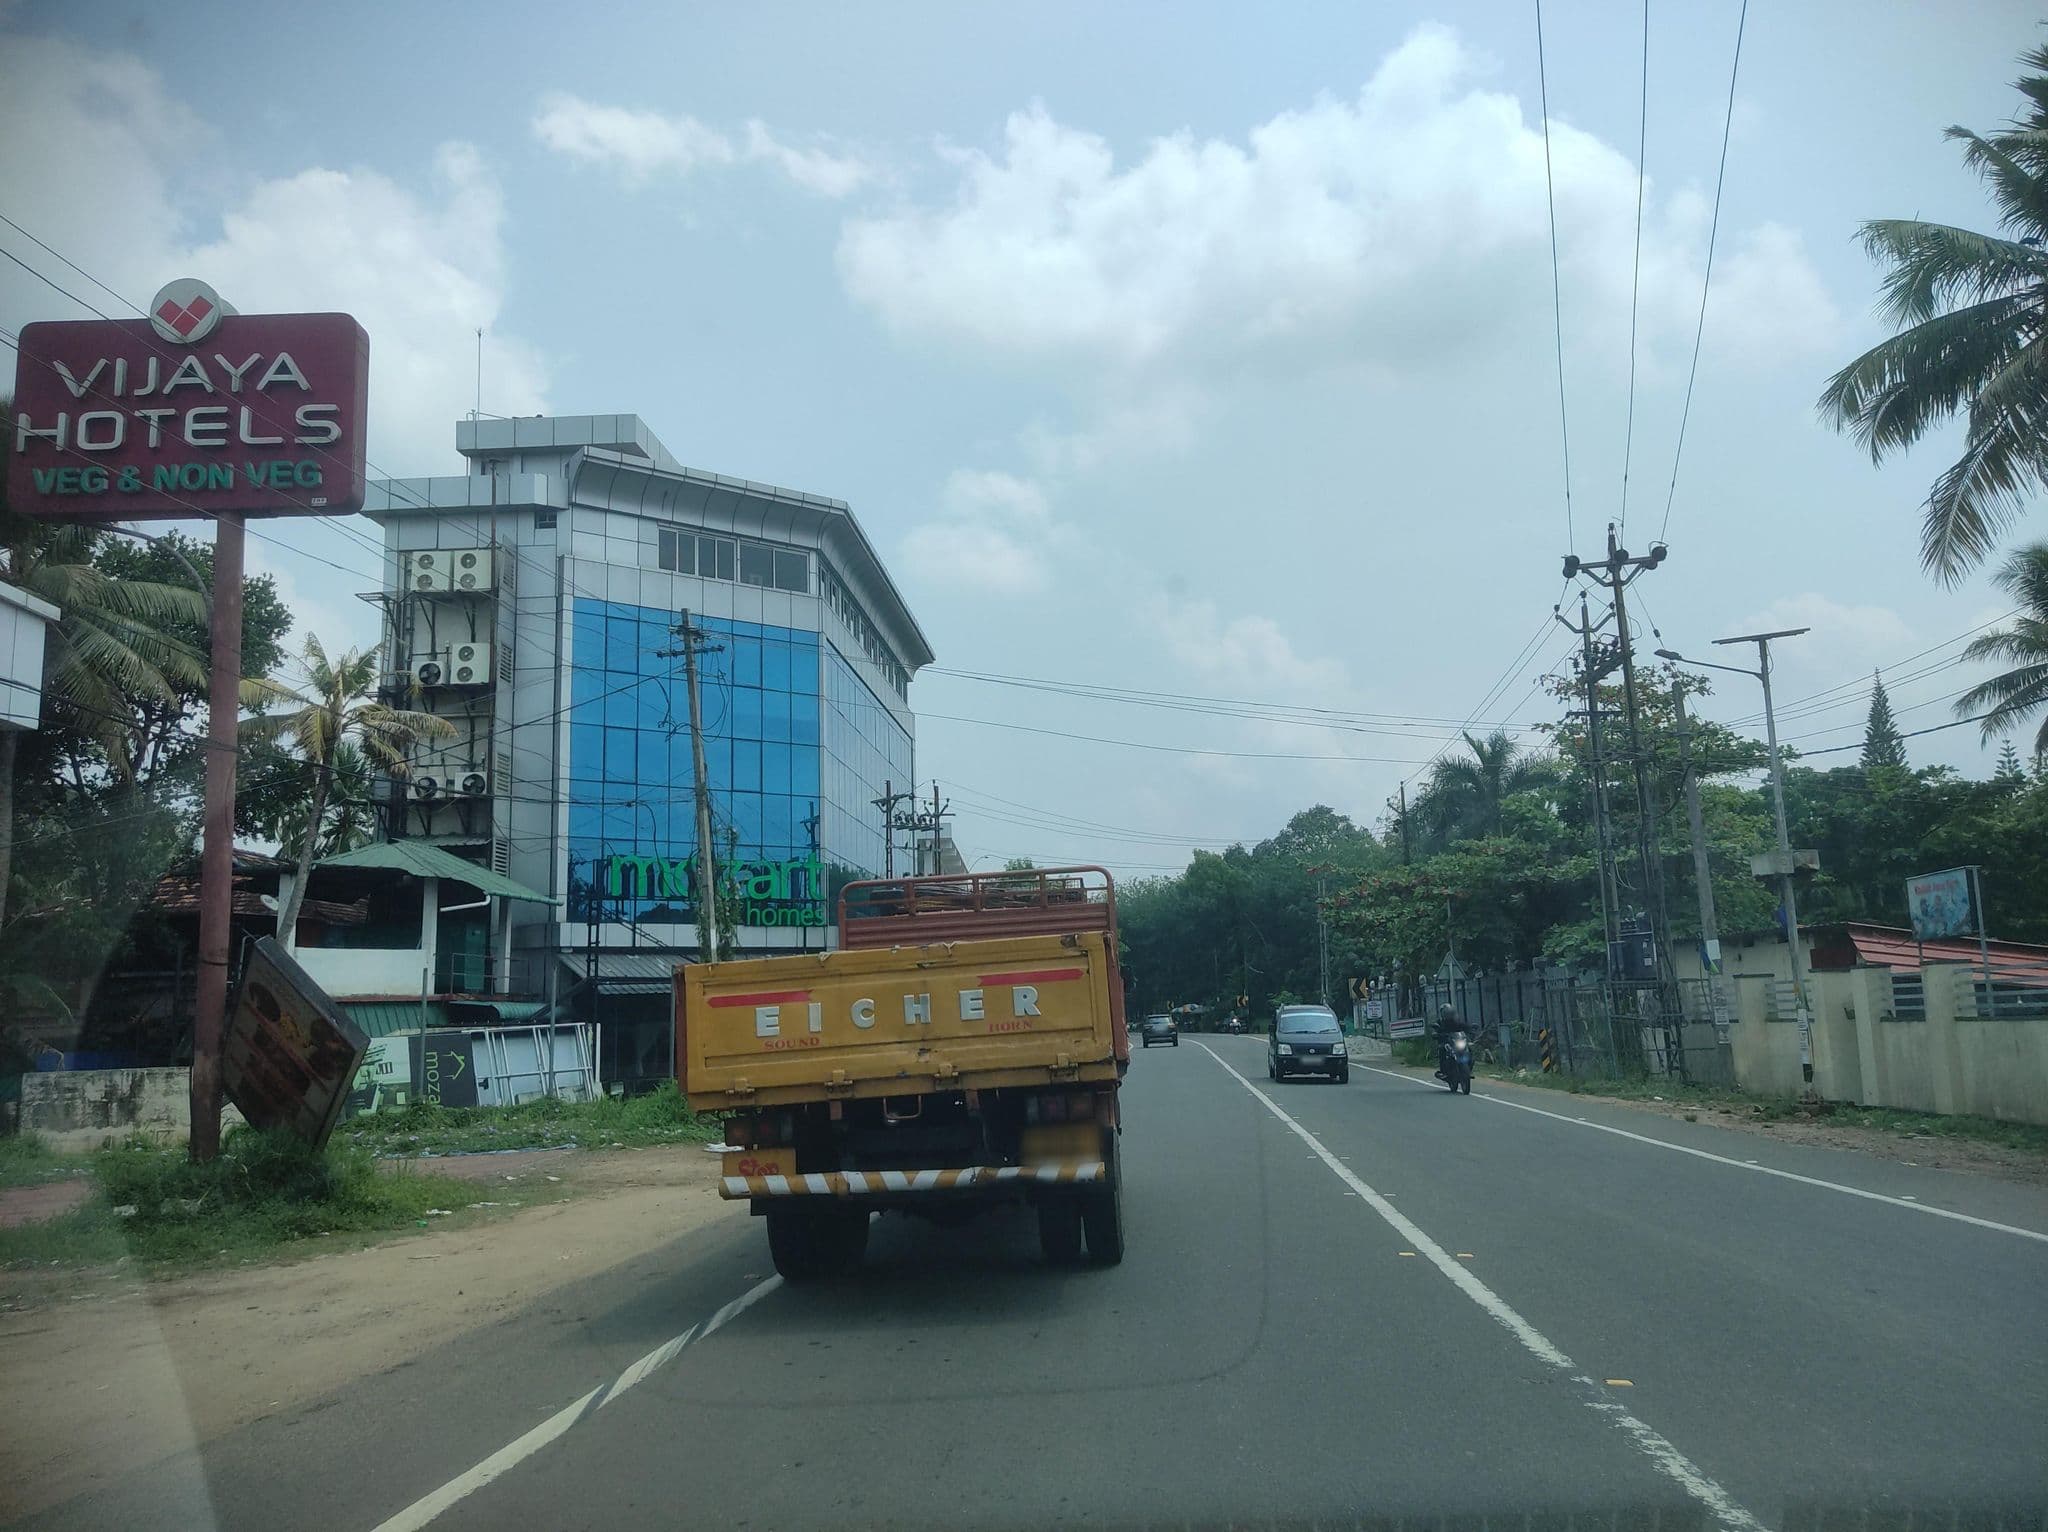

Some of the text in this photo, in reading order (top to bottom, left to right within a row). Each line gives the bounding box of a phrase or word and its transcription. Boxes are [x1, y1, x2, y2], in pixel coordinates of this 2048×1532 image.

[53, 352, 312, 398] VIJAYA
[16, 404, 342, 452] HOTELS
[32, 460, 323, 494] VEG & NON VEG
[746, 902, 825, 927] homes
[756, 986, 1041, 1037] EICHER
[764, 1019, 1033, 1050] SOUND HORN
